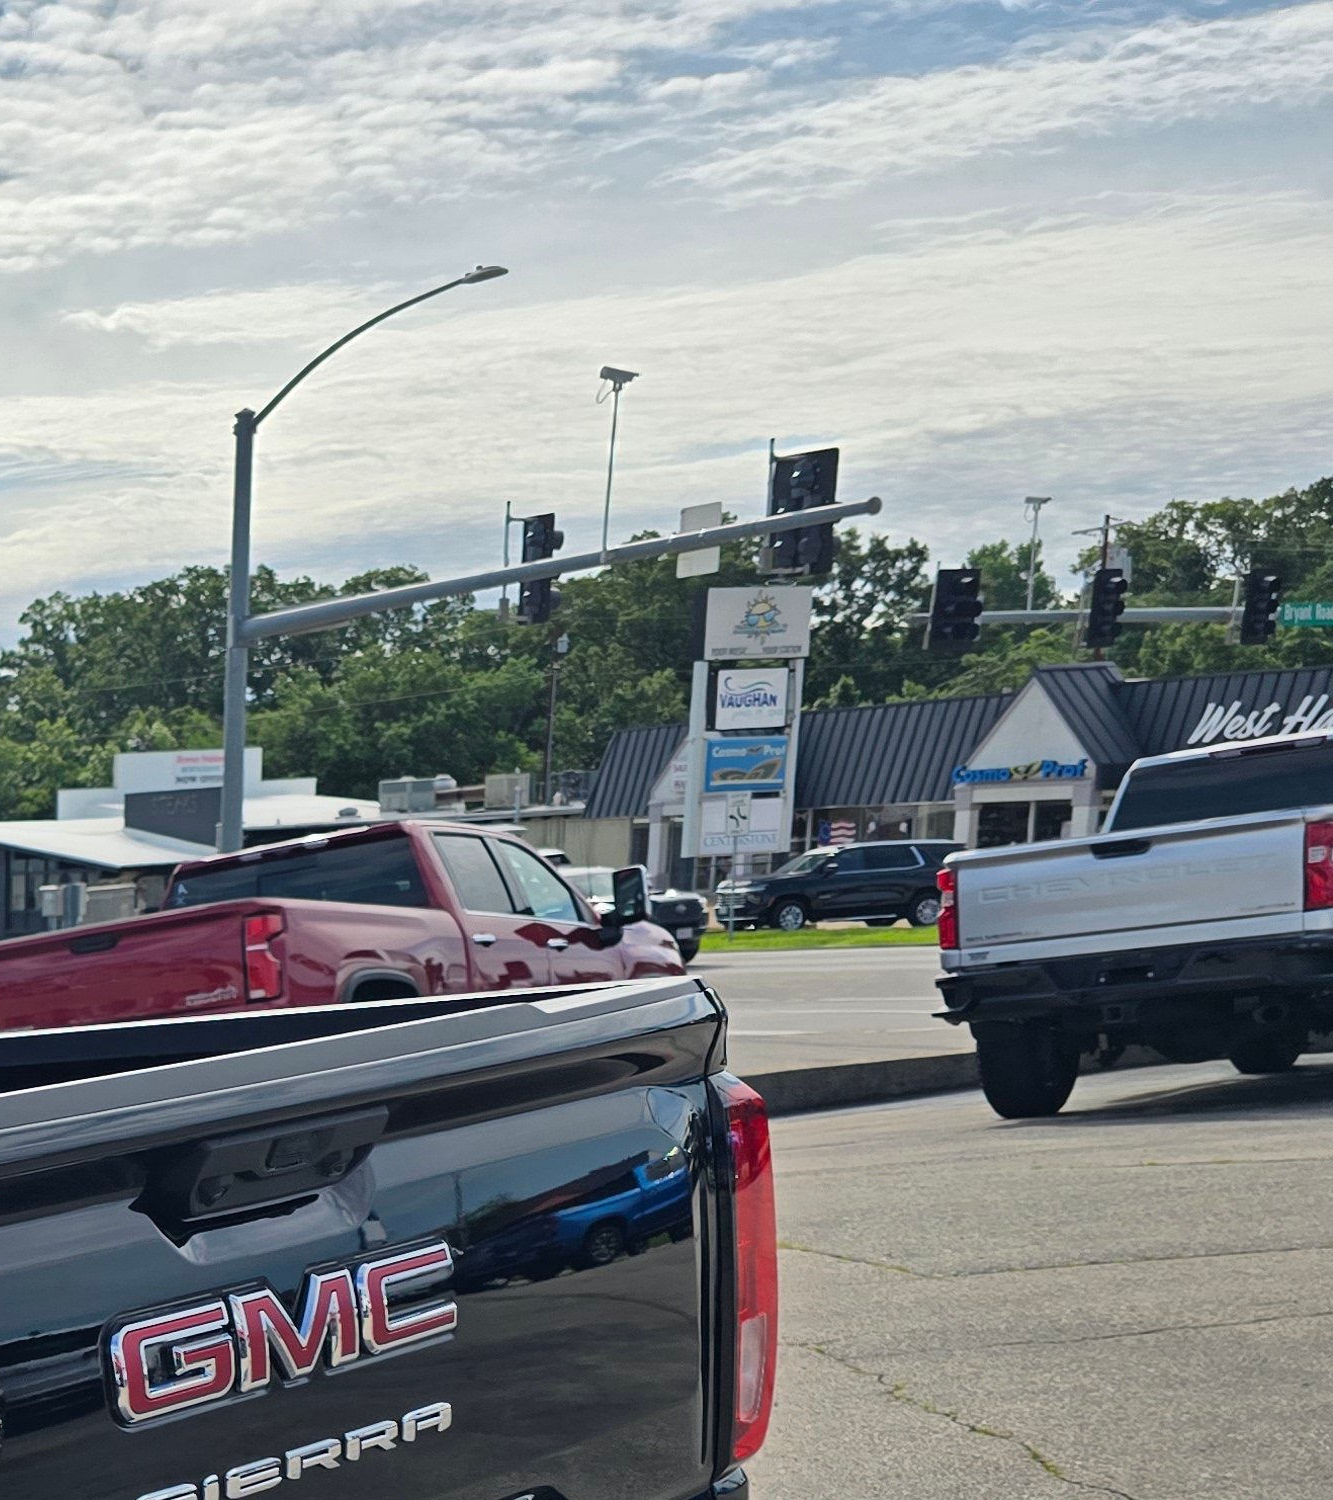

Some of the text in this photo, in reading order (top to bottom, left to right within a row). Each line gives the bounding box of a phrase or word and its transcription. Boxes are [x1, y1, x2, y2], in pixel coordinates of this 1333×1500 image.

[1284, 604, 1312, 623] Bryant
[720, 693, 777, 708] VAUGHAN
[1187, 700, 1281, 744] West
[763, 745, 786, 755] Prof
[952, 758, 1088, 783] Cosmo Prof
[978, 856, 1281, 904] CHEVROLET
[109, 1240, 457, 1424] GMC
